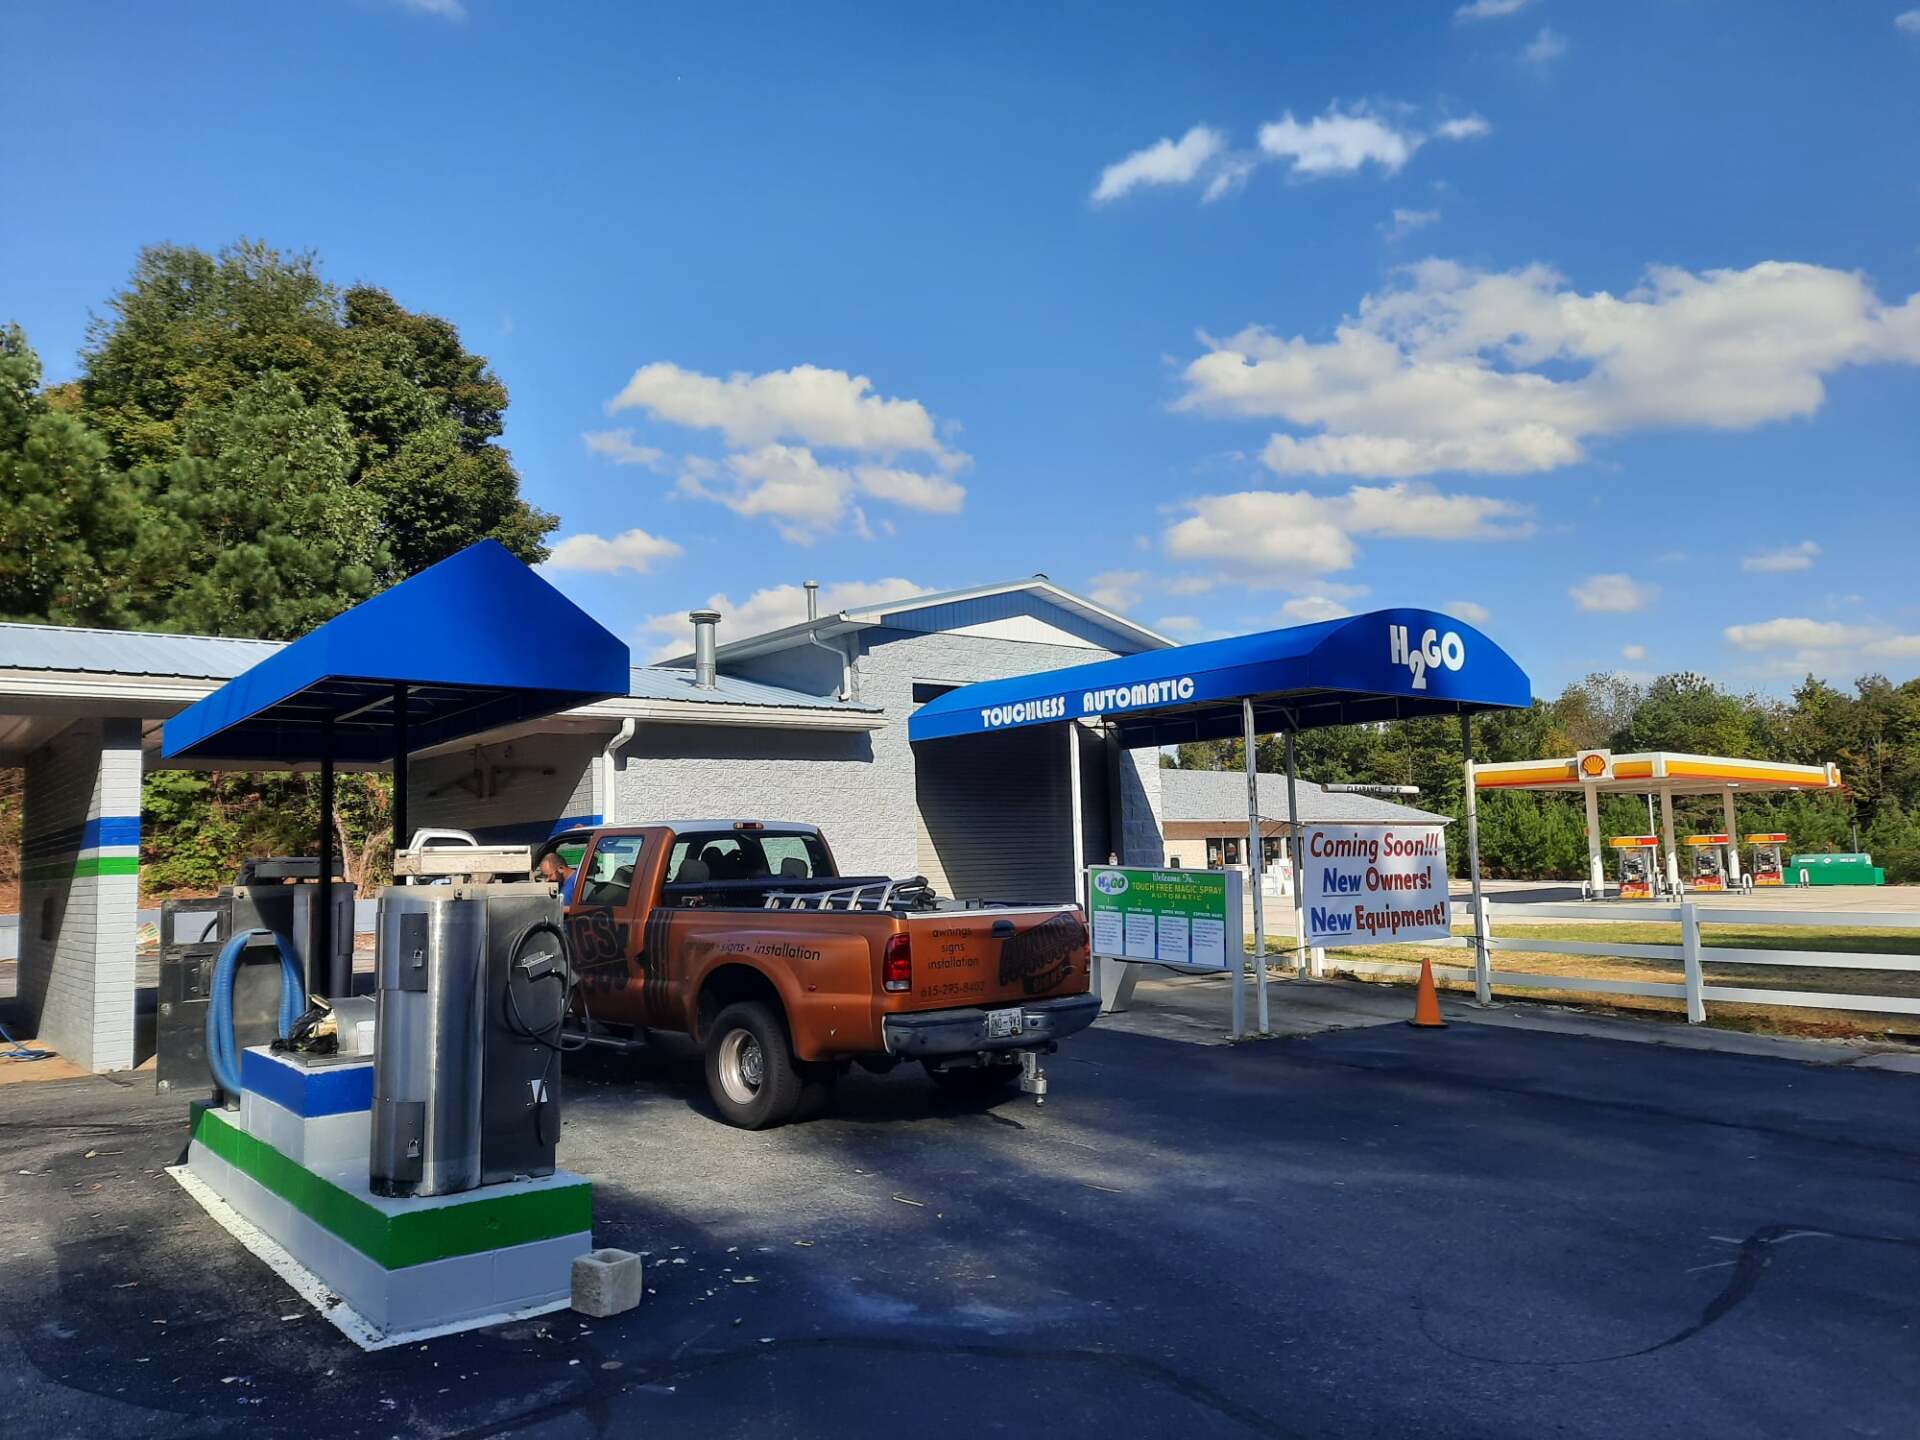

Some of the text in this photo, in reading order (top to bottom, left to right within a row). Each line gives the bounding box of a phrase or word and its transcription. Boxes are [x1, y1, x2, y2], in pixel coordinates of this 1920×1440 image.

[1389, 624, 1465, 689] H2GO
[981, 677, 1195, 727] TOUCHLESS AUTOMATIC
[1310, 832, 1439, 863] Coming Soon!!!
[1322, 865, 1432, 893] New Owners!
[1132, 882, 1222, 895] TOUCH FREE MAGIC SPRAY
[1151, 893, 1202, 901] AUTOMATIC
[1311, 901, 1446, 936] New Equipment!
[932, 927, 972, 938] awnings
[754, 942, 821, 960] installation
[941, 941, 965, 954] signs
[928, 957, 979, 969] installation
